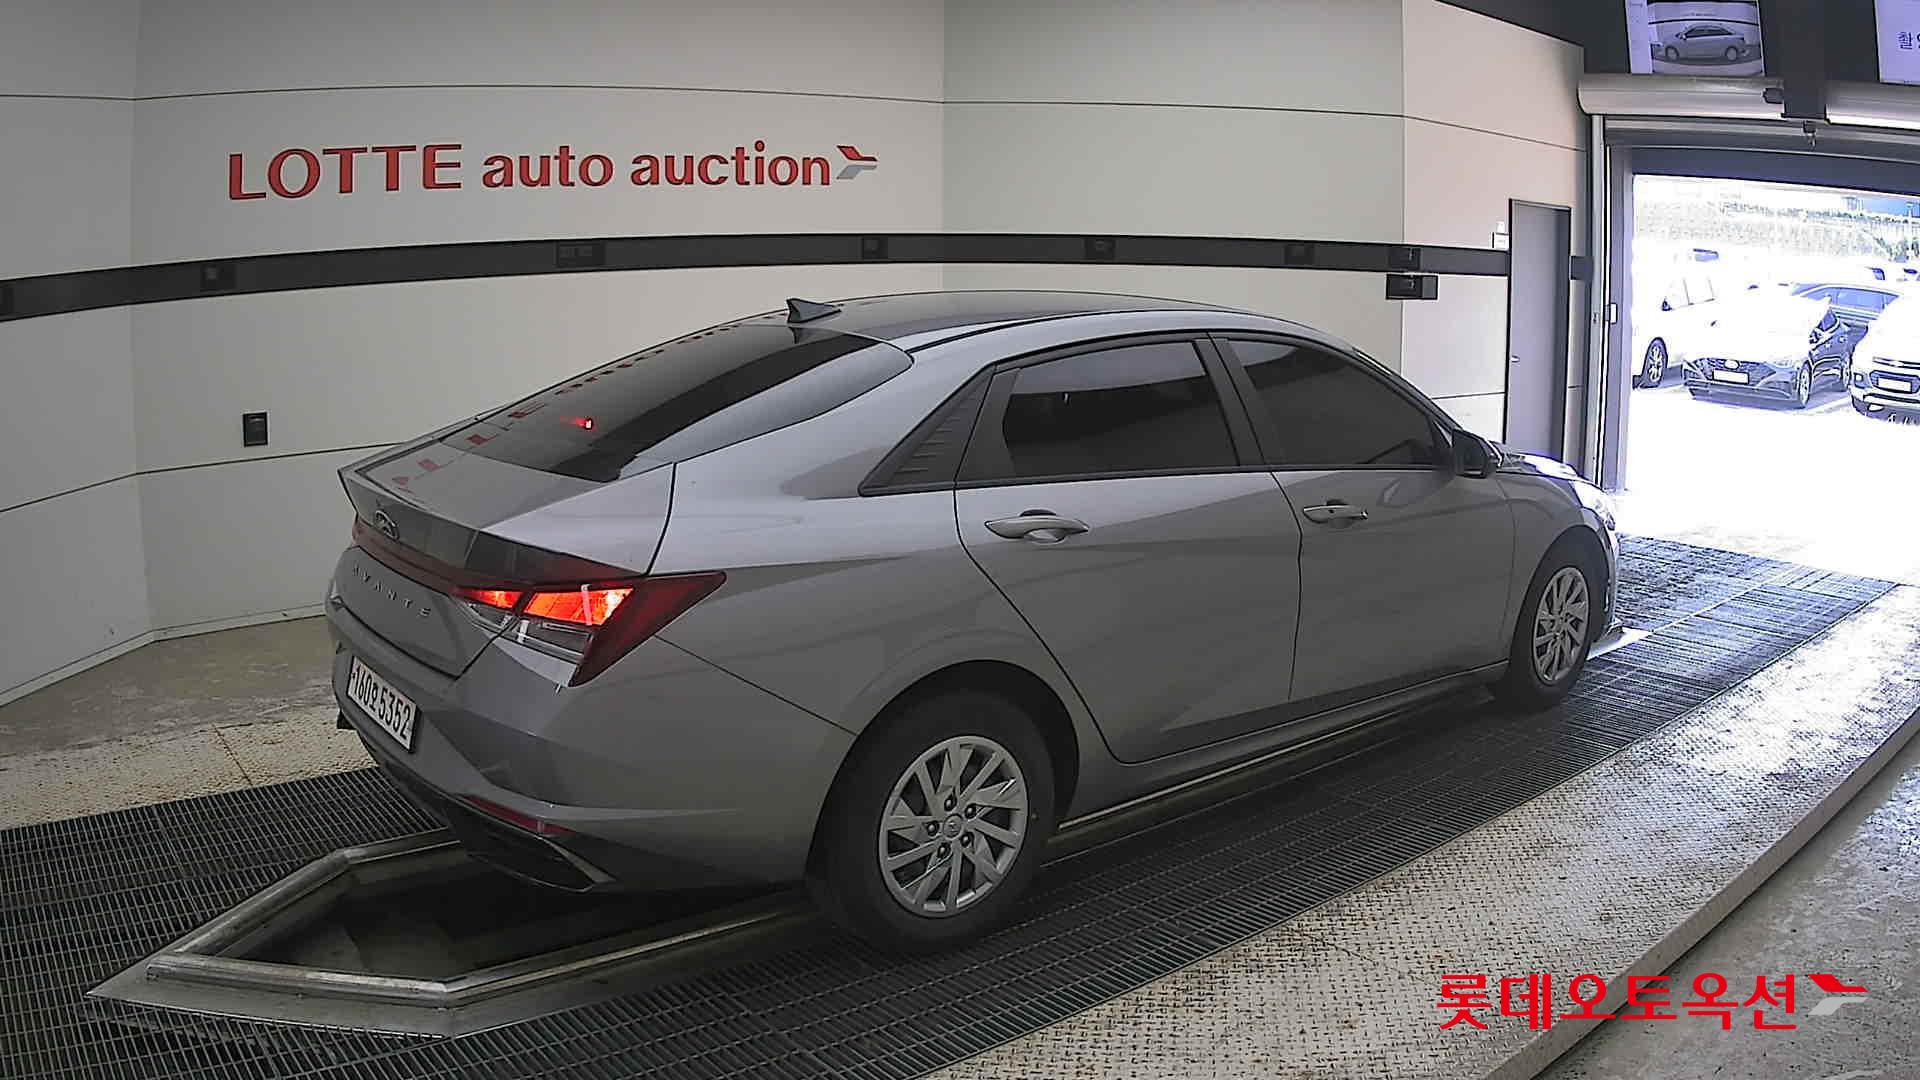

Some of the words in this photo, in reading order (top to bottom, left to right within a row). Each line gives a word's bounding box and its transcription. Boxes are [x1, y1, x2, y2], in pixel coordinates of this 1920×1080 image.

[228, 143, 462, 201] LOTTE
[482, 145, 615, 188] auto
[630, 140, 831, 187] auction
[352, 564, 432, 617] AVANTE
